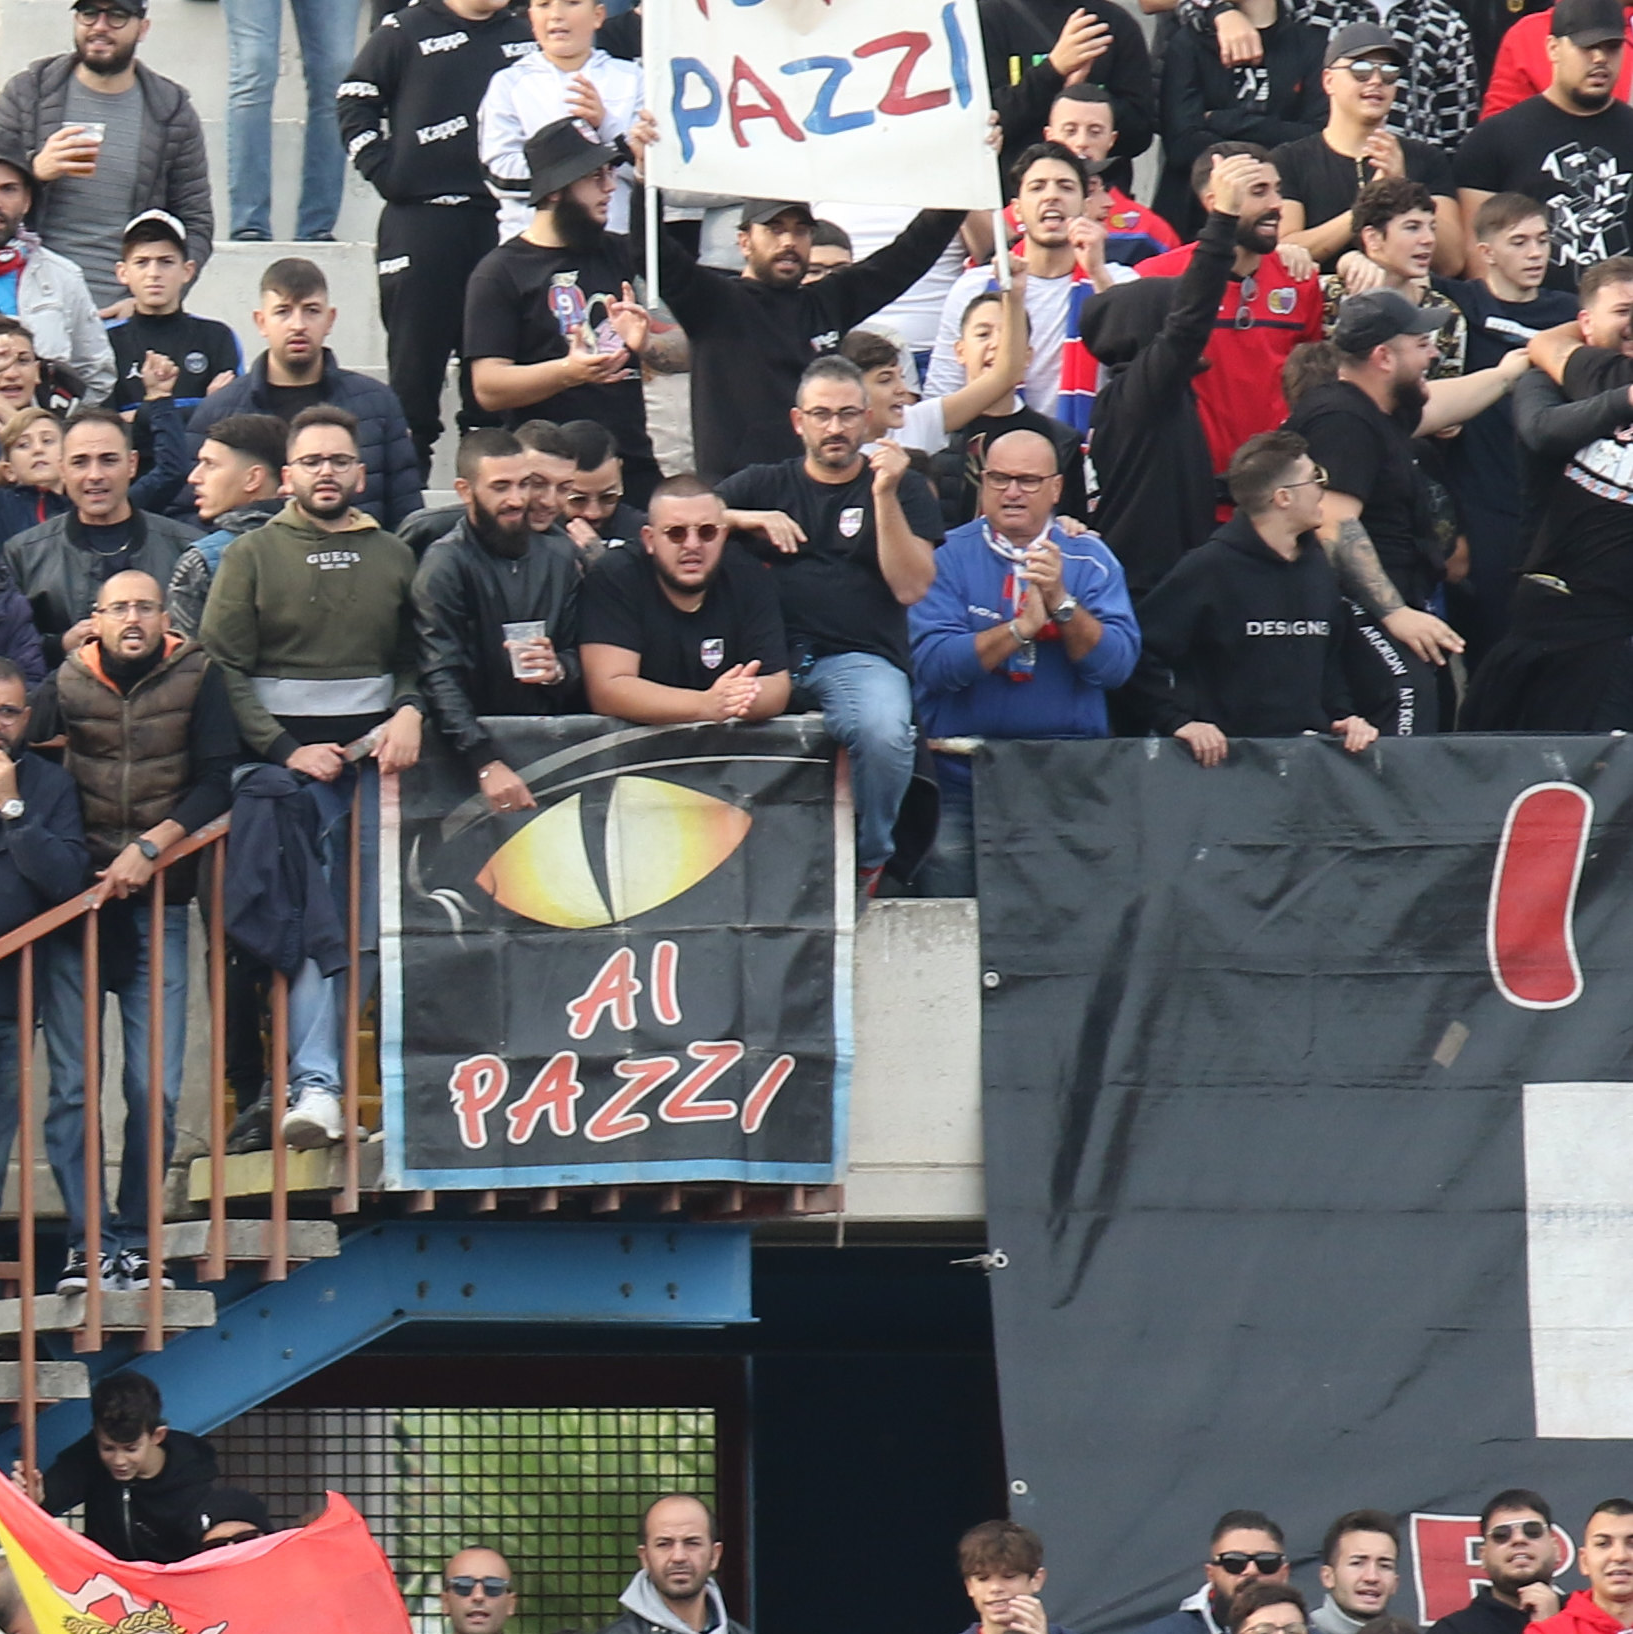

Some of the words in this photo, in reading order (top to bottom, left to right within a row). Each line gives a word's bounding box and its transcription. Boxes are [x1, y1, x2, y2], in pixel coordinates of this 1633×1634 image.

[420, 31, 469, 55] Kappa
[671, 2, 974, 163] PAZZI
[416, 115, 469, 145] Kappa
[306, 551, 360, 565] GUESS
[566, 940, 684, 1040] AI
[448, 1039, 797, 1151] PAZZI
